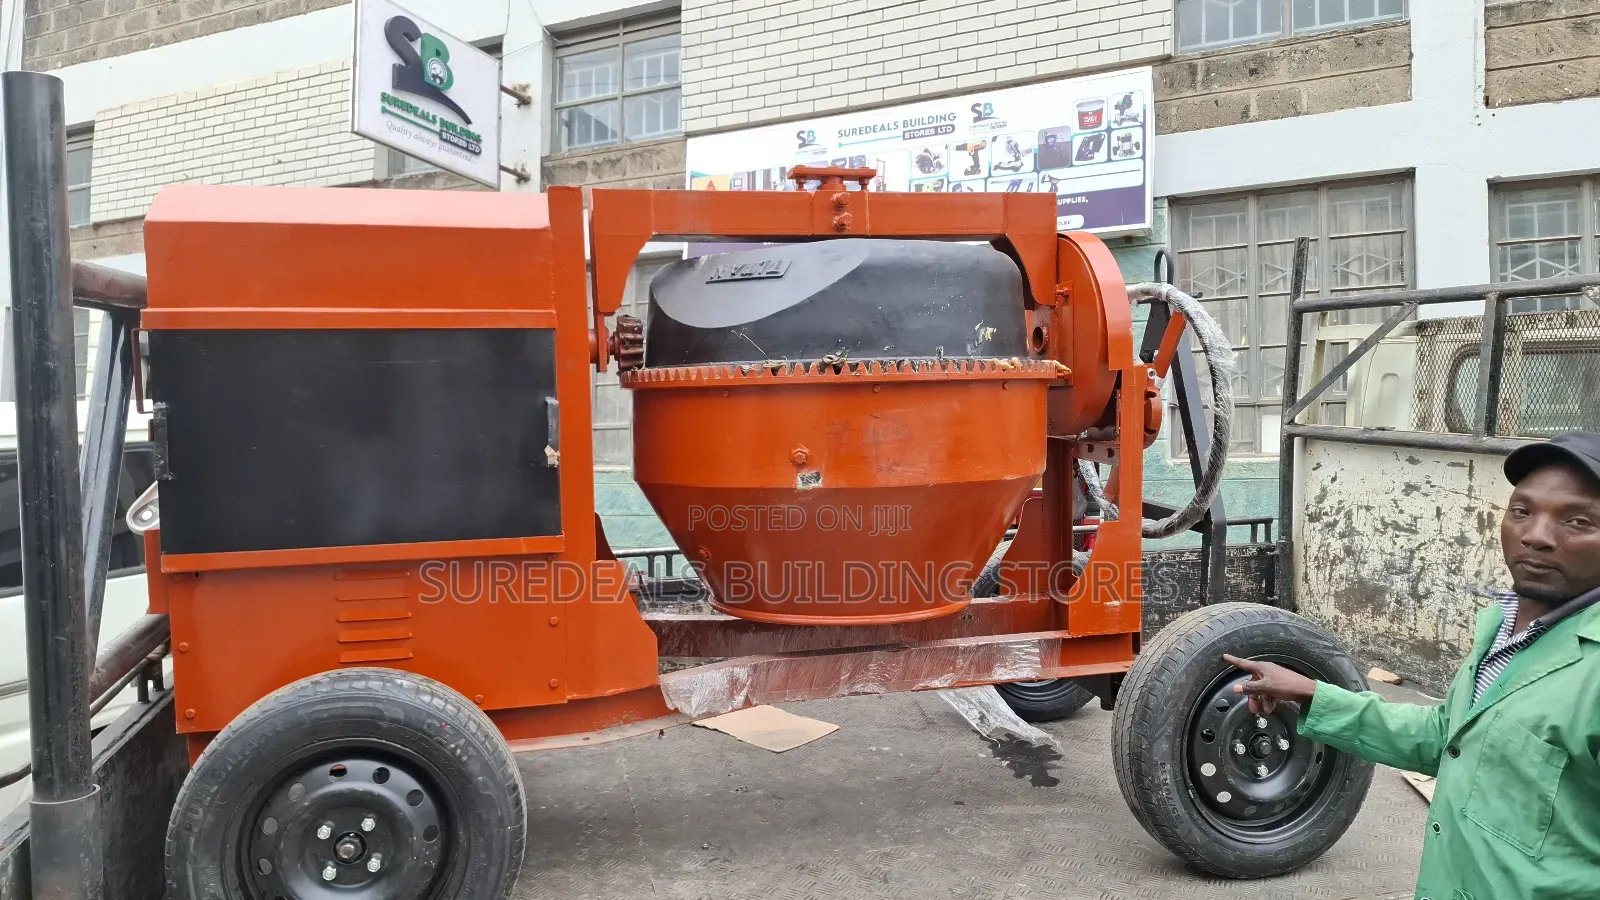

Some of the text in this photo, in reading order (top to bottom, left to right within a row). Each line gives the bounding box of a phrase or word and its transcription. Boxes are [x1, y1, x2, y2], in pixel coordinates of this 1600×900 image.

[384, 15, 456, 93] SB
[380, 92, 482, 143] SUREDEALS BUILDING
[838, 121, 899, 138] SUREDEALS
[902, 112, 957, 129] BUILDING
[386, 120, 412, 139] Quality
[413, 132, 437, 148] always
[441, 131, 481, 153] STORES LTD
[904, 125, 953, 139] STORES LTD
[1057, 196, 1089, 205] UPPLIES,
